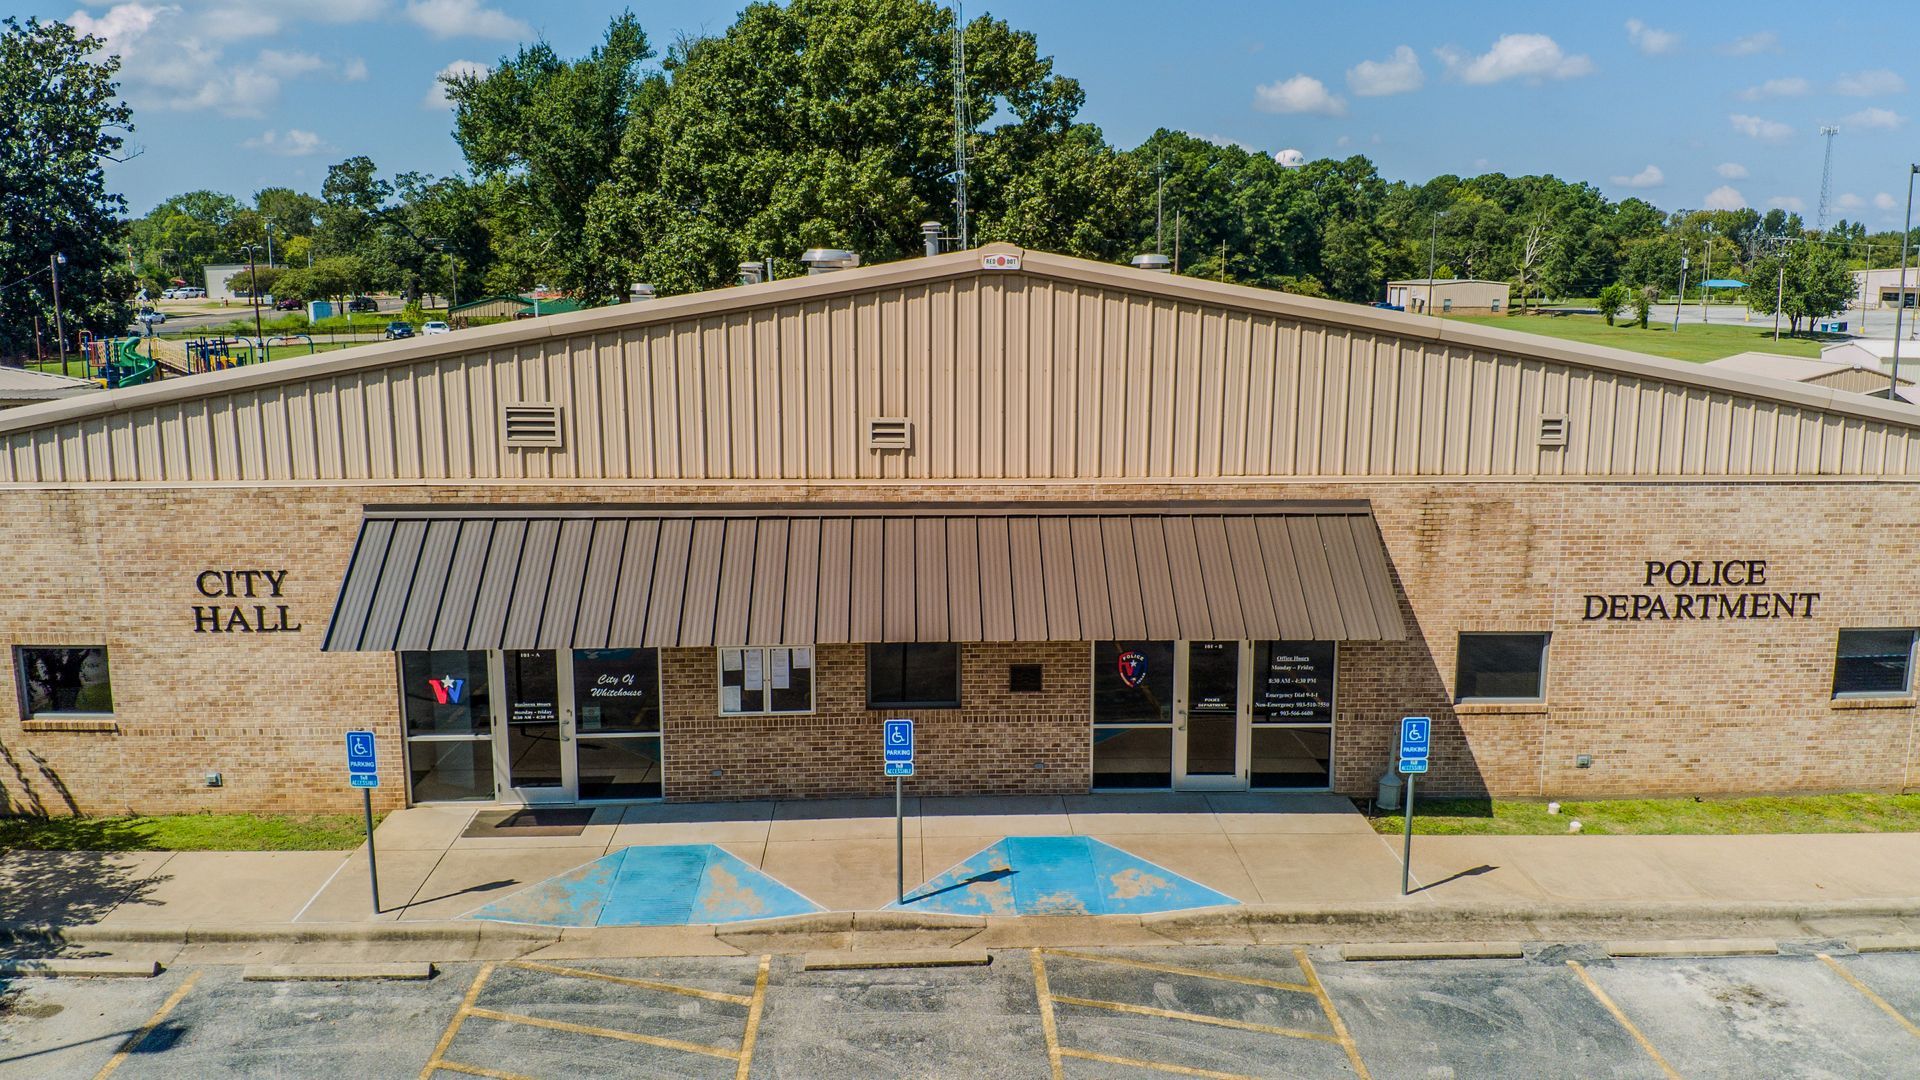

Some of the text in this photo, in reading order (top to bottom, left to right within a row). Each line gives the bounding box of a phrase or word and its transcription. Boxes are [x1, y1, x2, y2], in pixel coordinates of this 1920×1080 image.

[196, 570, 288, 598] CITY
[1643, 560, 1767, 587] POLICE
[191, 605, 302, 632] HALL
[1582, 593, 1820, 621] DEPARTMENT
[590, 687, 642, 697] Whitehouse
[597, 674, 635, 685] City Of
